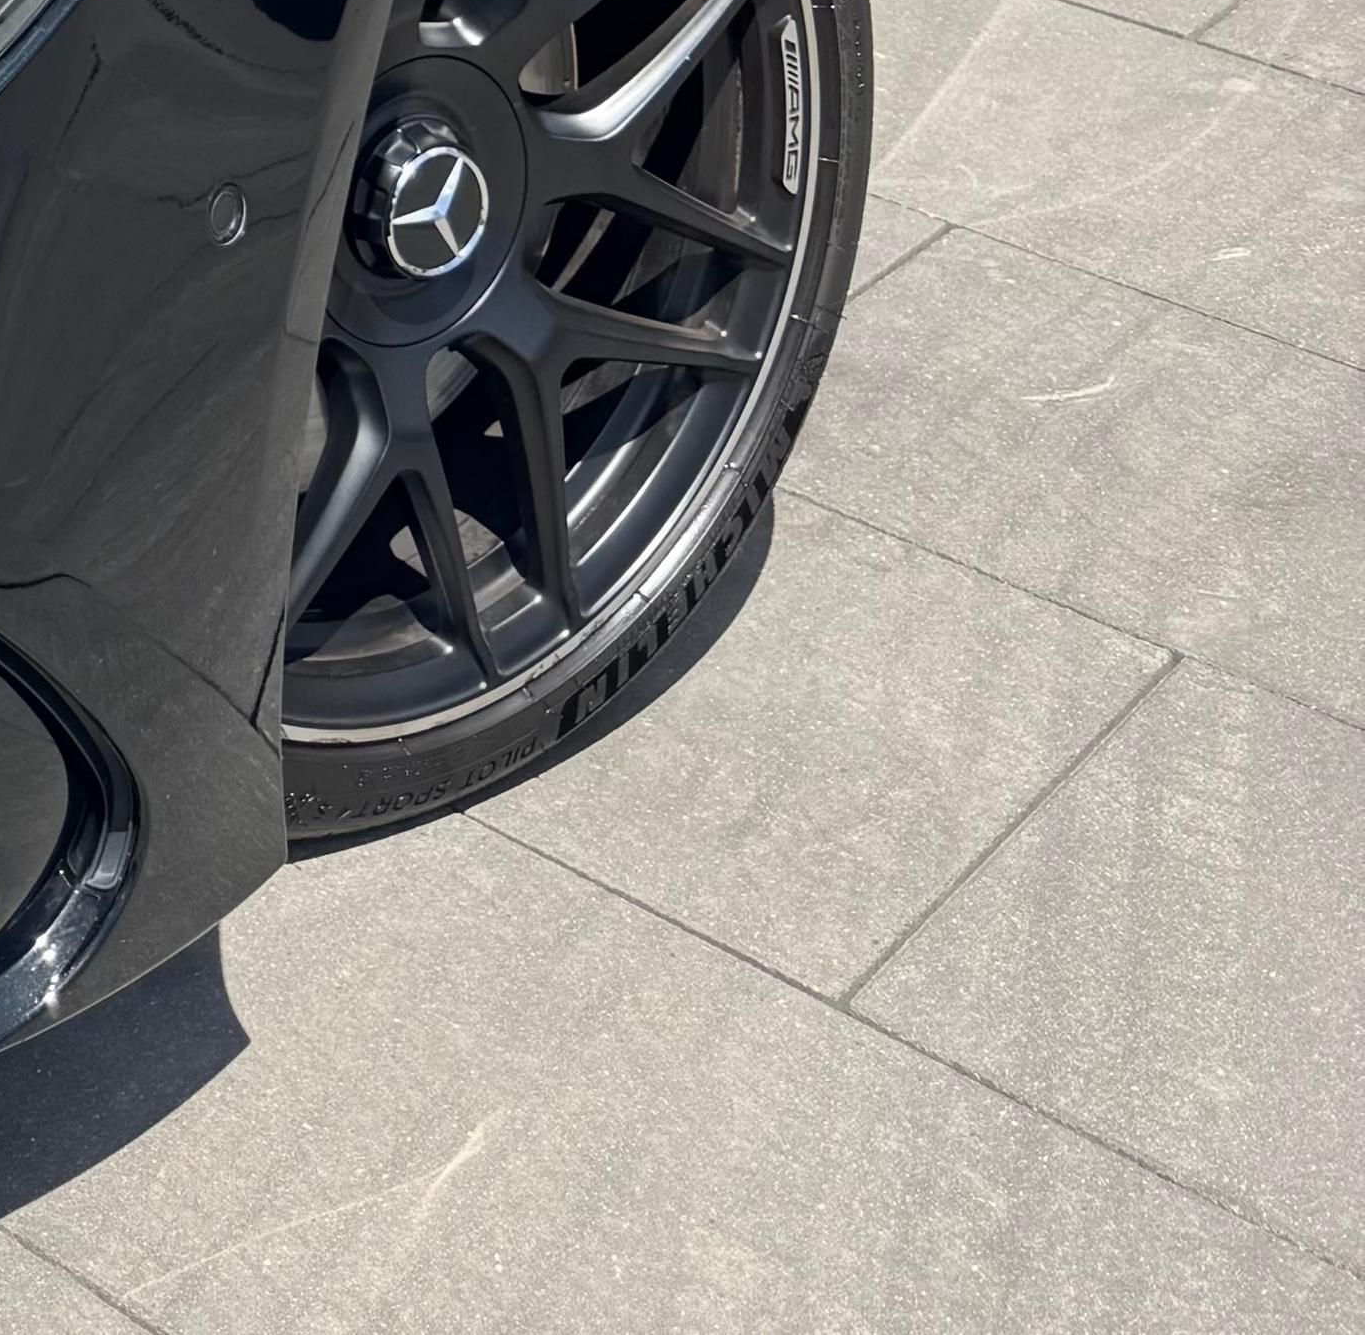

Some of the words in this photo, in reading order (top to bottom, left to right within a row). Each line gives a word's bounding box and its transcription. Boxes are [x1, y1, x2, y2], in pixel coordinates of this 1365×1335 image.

[573, 423, 793, 725] MICHELIN
[461, 735, 537, 790] PILOT
[352, 780, 452, 820] SPORT
